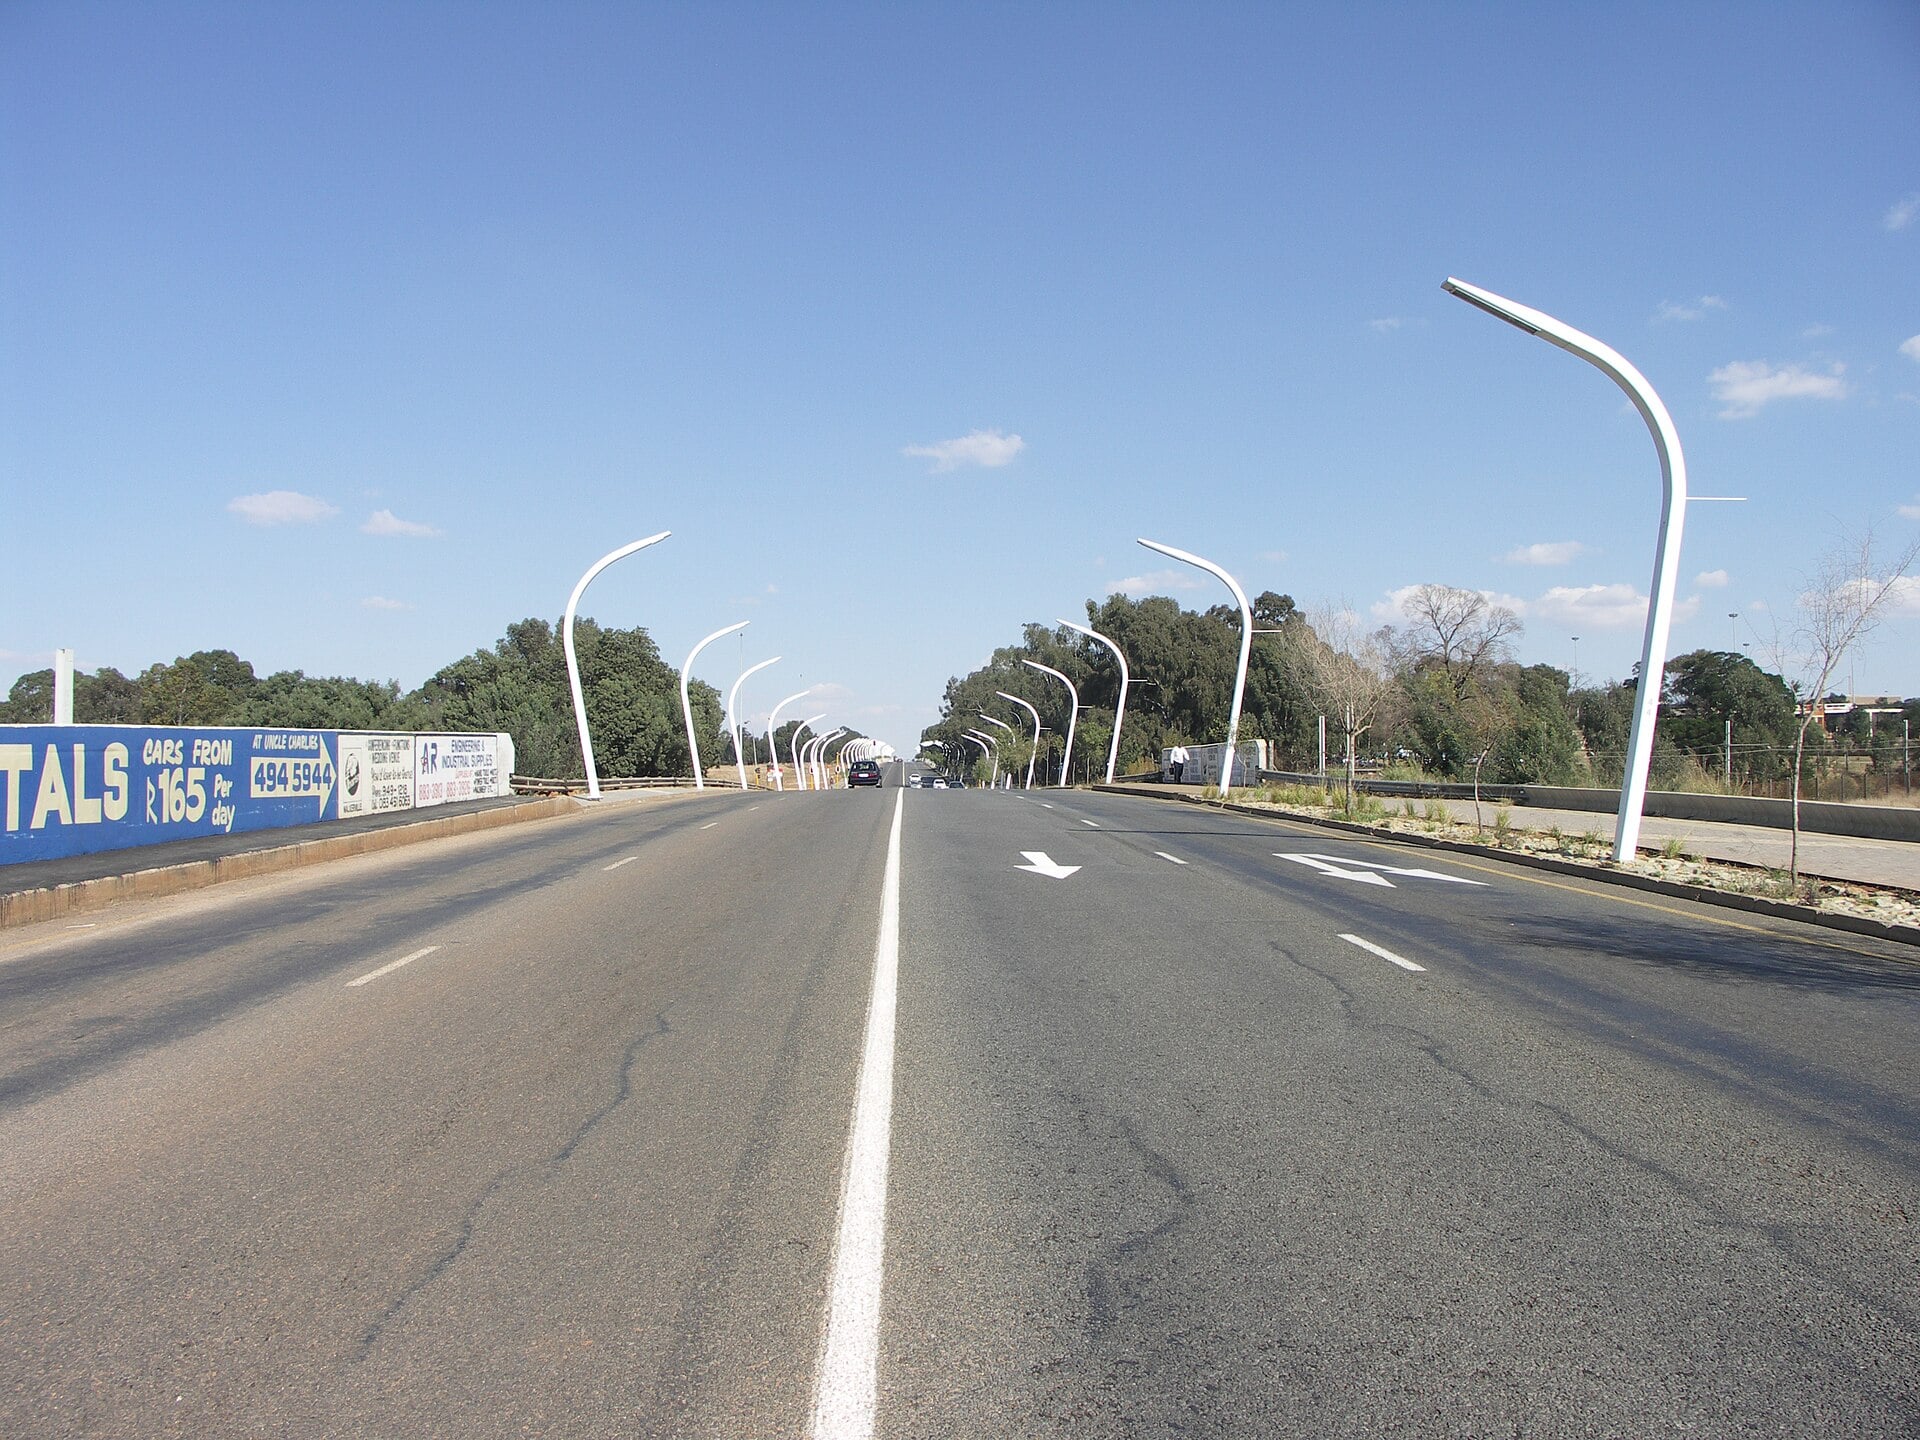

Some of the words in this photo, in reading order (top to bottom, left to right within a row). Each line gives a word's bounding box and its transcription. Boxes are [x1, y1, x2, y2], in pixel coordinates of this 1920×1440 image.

[143, 738, 184, 766] CARS
[193, 738, 233, 766] FROM
[252, 734, 263, 749] AT
[264, 734, 287, 750] UNCLE
[422, 742, 438, 774] AR
[0, 742, 129, 832] TALS
[214, 773, 233, 798] Per
[254, 761, 289, 792] 494
[291, 762, 332, 792] 5944
[211, 800, 236, 833] day
